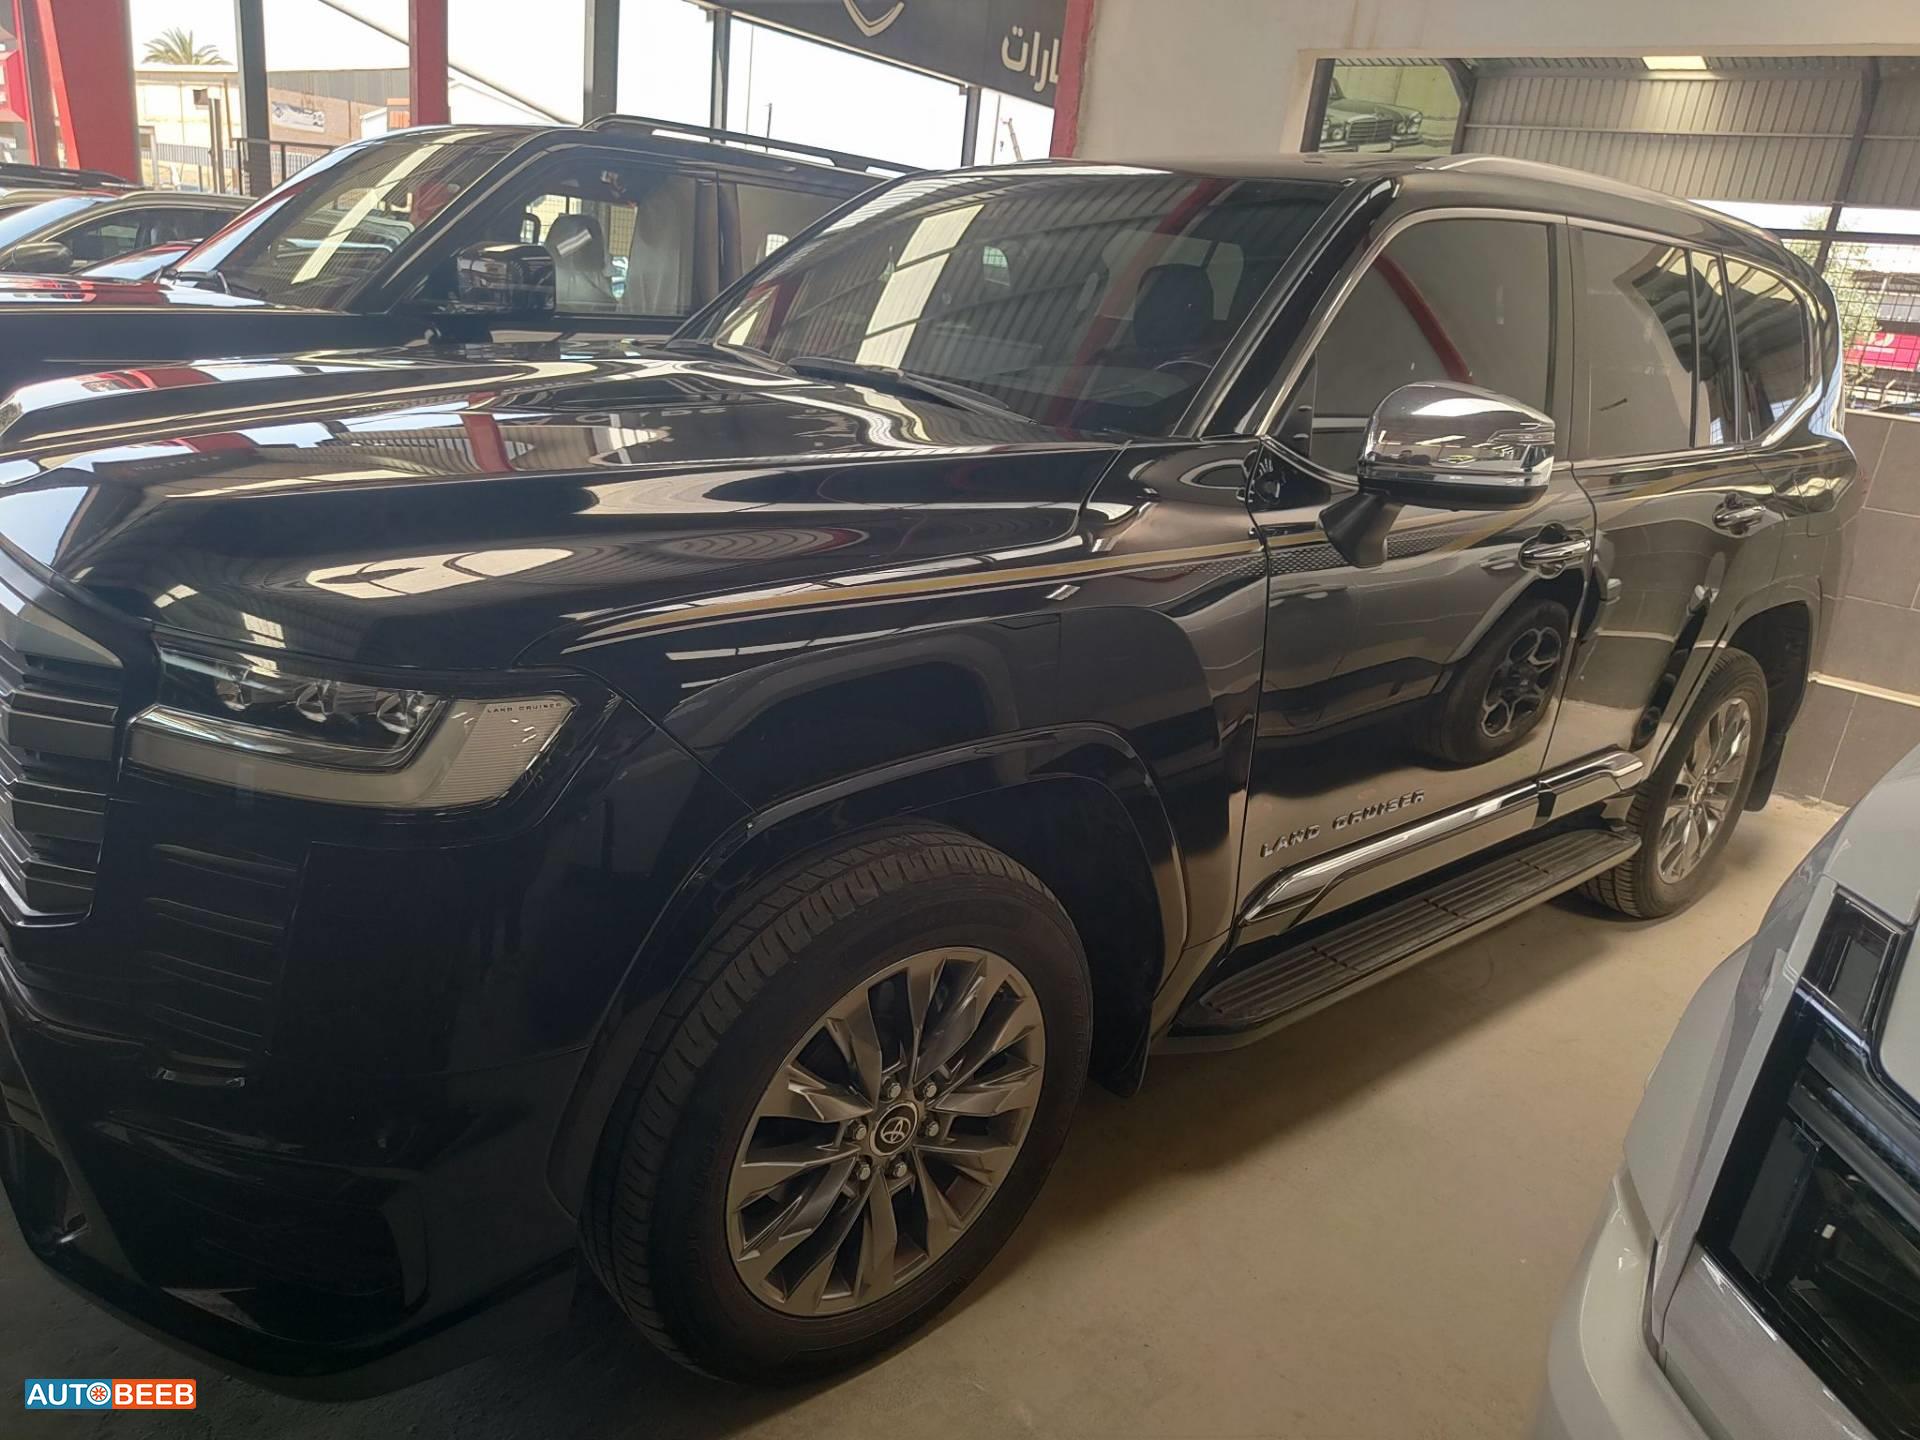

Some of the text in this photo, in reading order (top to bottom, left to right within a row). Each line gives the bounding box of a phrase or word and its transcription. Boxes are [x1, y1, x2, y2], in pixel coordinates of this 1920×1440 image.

[1002, 25, 1060, 92] ارات
[519, 703, 561, 711] CRUISER
[1260, 789, 1425, 858] LAND CRUISER
